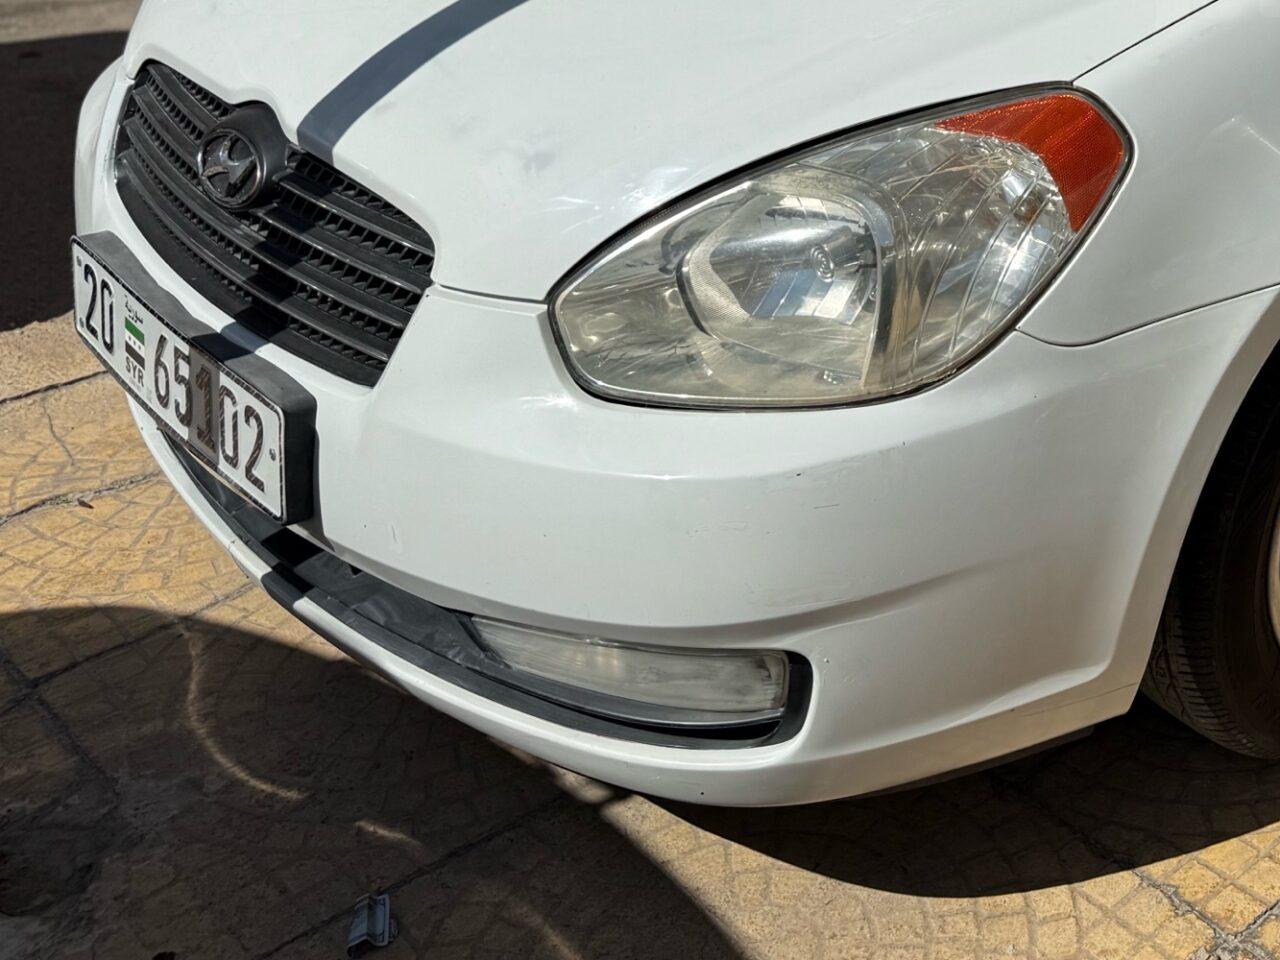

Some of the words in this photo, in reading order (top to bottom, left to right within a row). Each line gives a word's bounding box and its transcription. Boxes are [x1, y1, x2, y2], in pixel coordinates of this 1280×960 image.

[83, 263, 114, 356] 20
[154, 334, 265, 494] 65102
[125, 356, 145, 388] SYR
